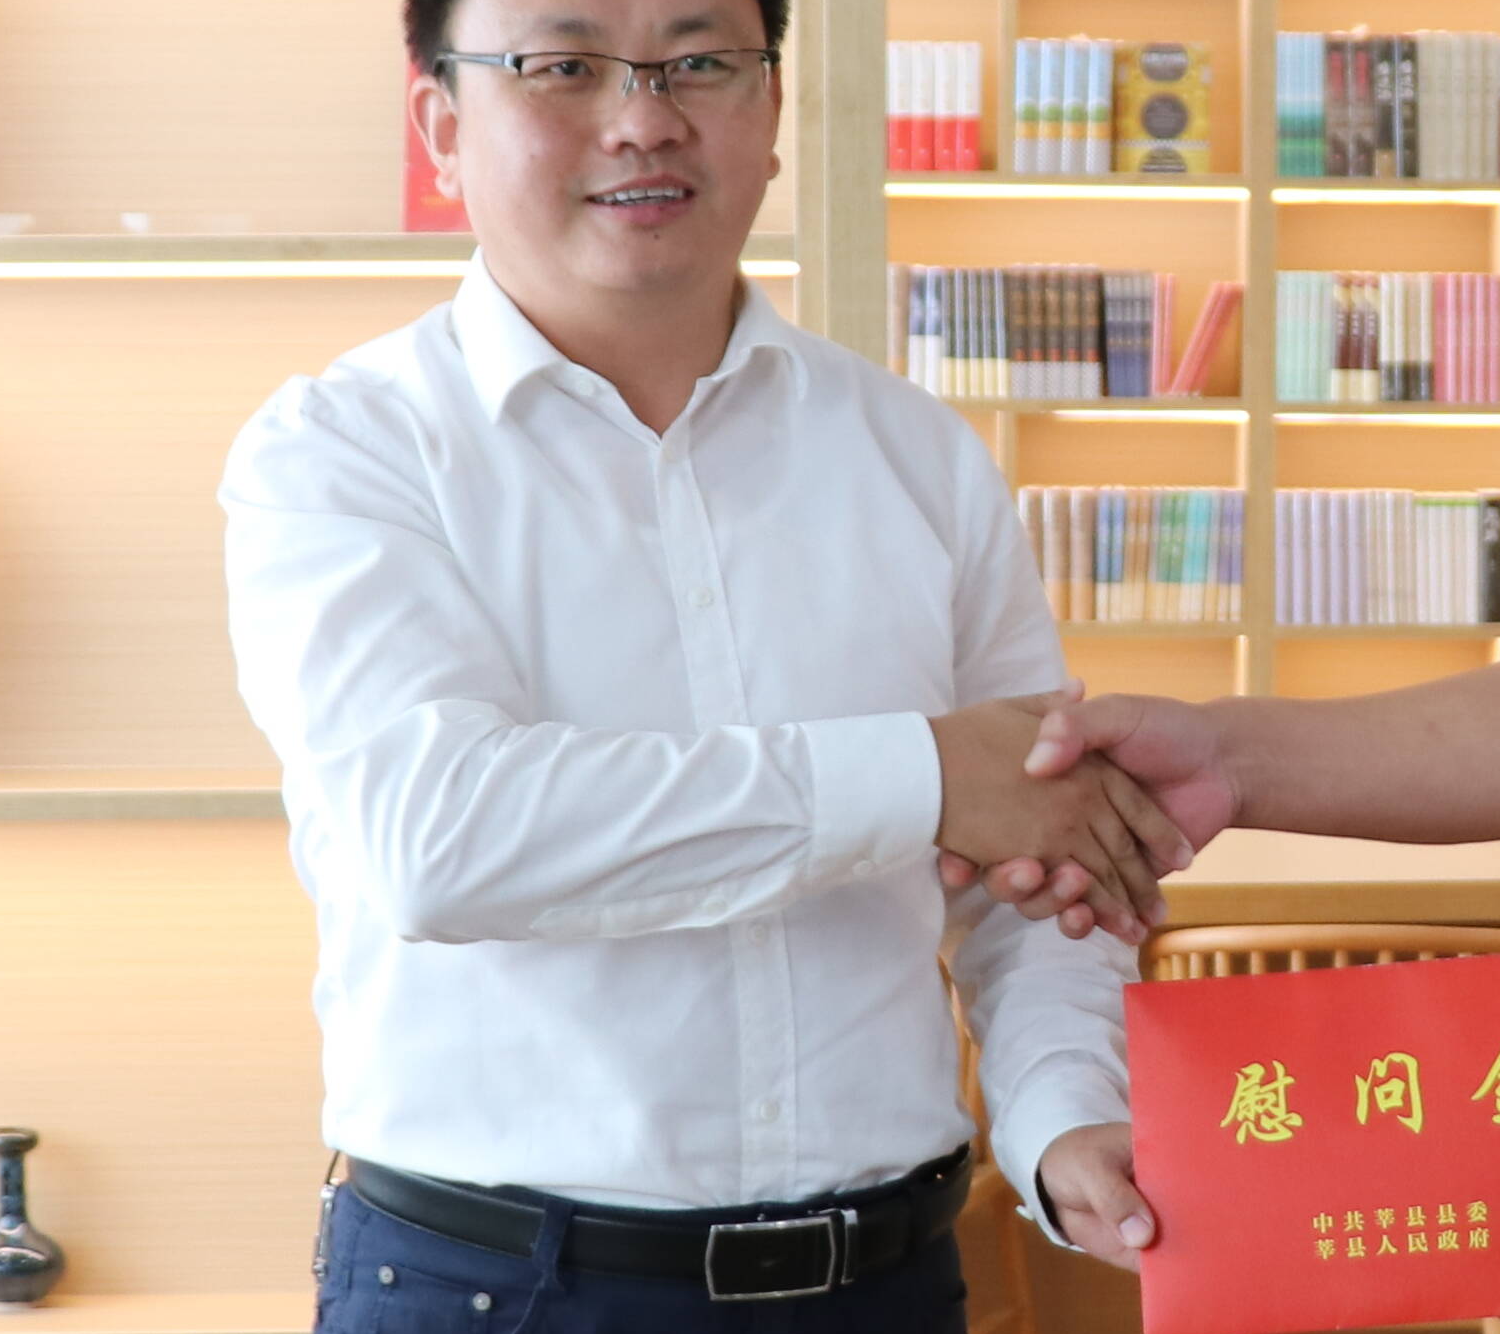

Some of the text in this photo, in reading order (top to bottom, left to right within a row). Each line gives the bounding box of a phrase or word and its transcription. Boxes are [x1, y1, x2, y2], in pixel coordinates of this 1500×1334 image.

[1312, 1200, 1489, 1234] 中共莘县县委
[1314, 1227, 1490, 1260] 莘县人民政府
